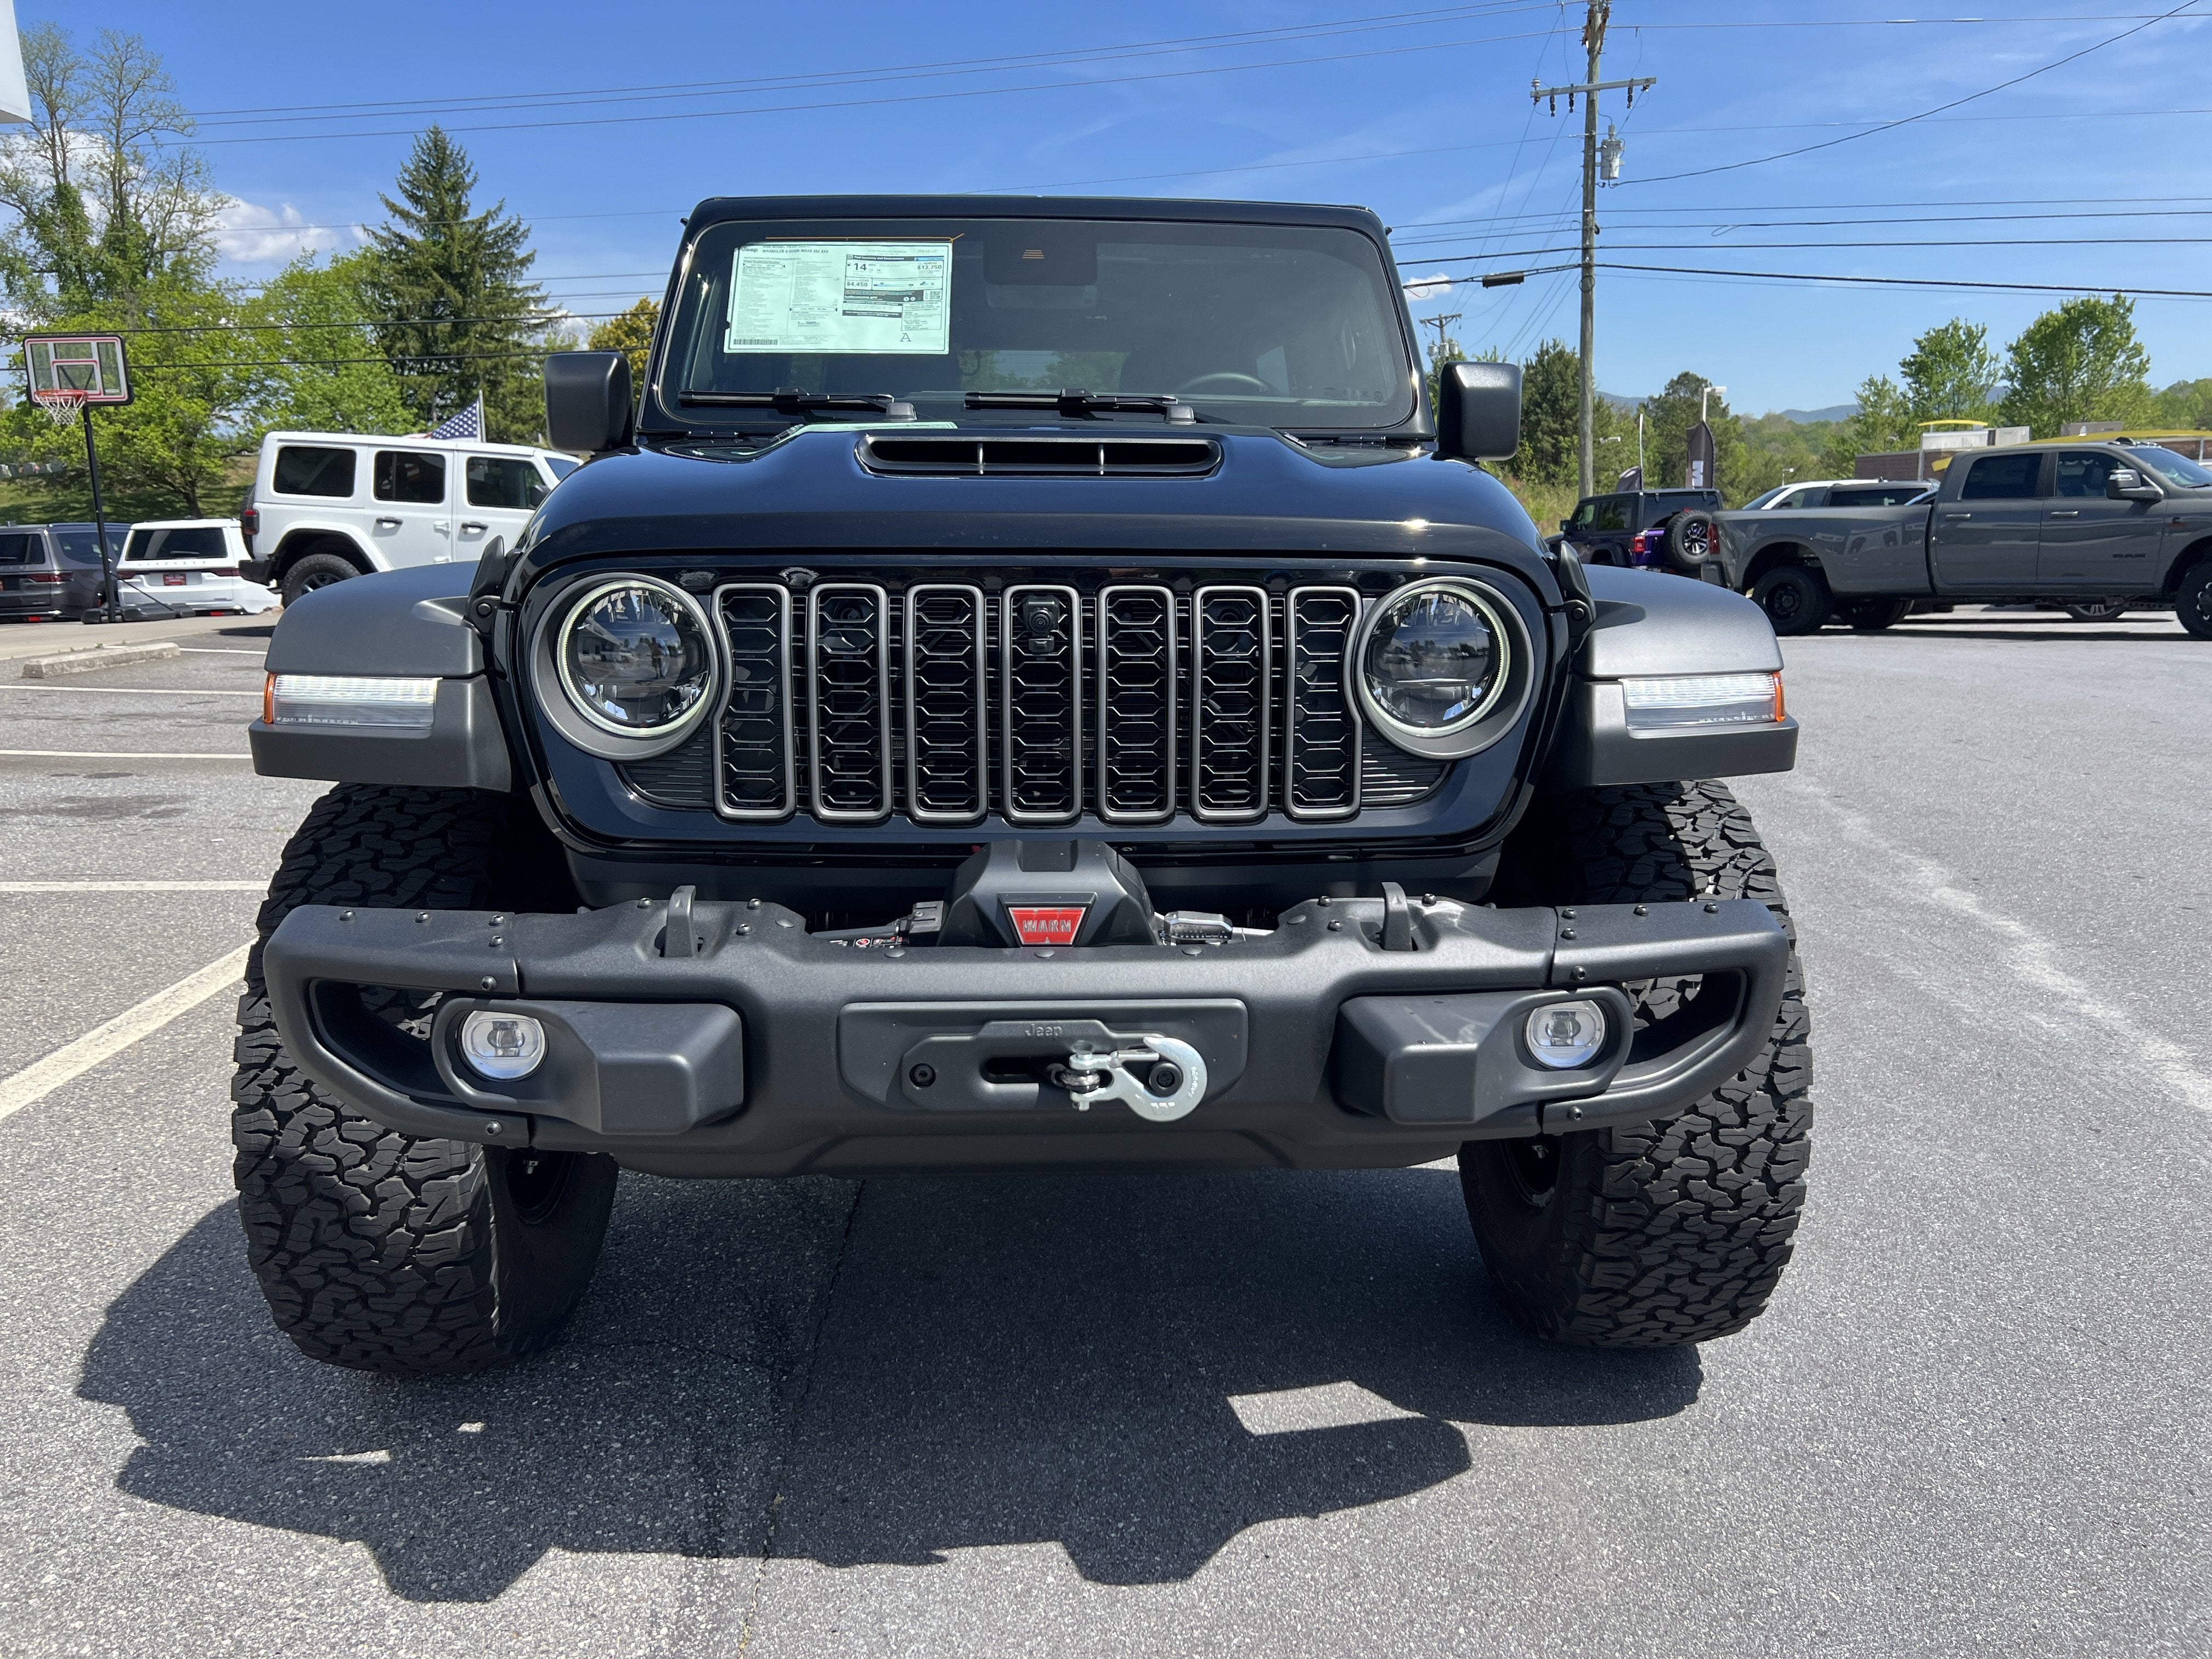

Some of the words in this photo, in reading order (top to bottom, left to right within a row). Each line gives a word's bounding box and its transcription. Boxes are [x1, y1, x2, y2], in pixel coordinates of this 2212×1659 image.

[854, 263, 867, 271] 14
[900, 333, 911, 342] A
[1023, 919, 1071, 932] WARN
[1025, 1023, 1063, 1039] Jeep
